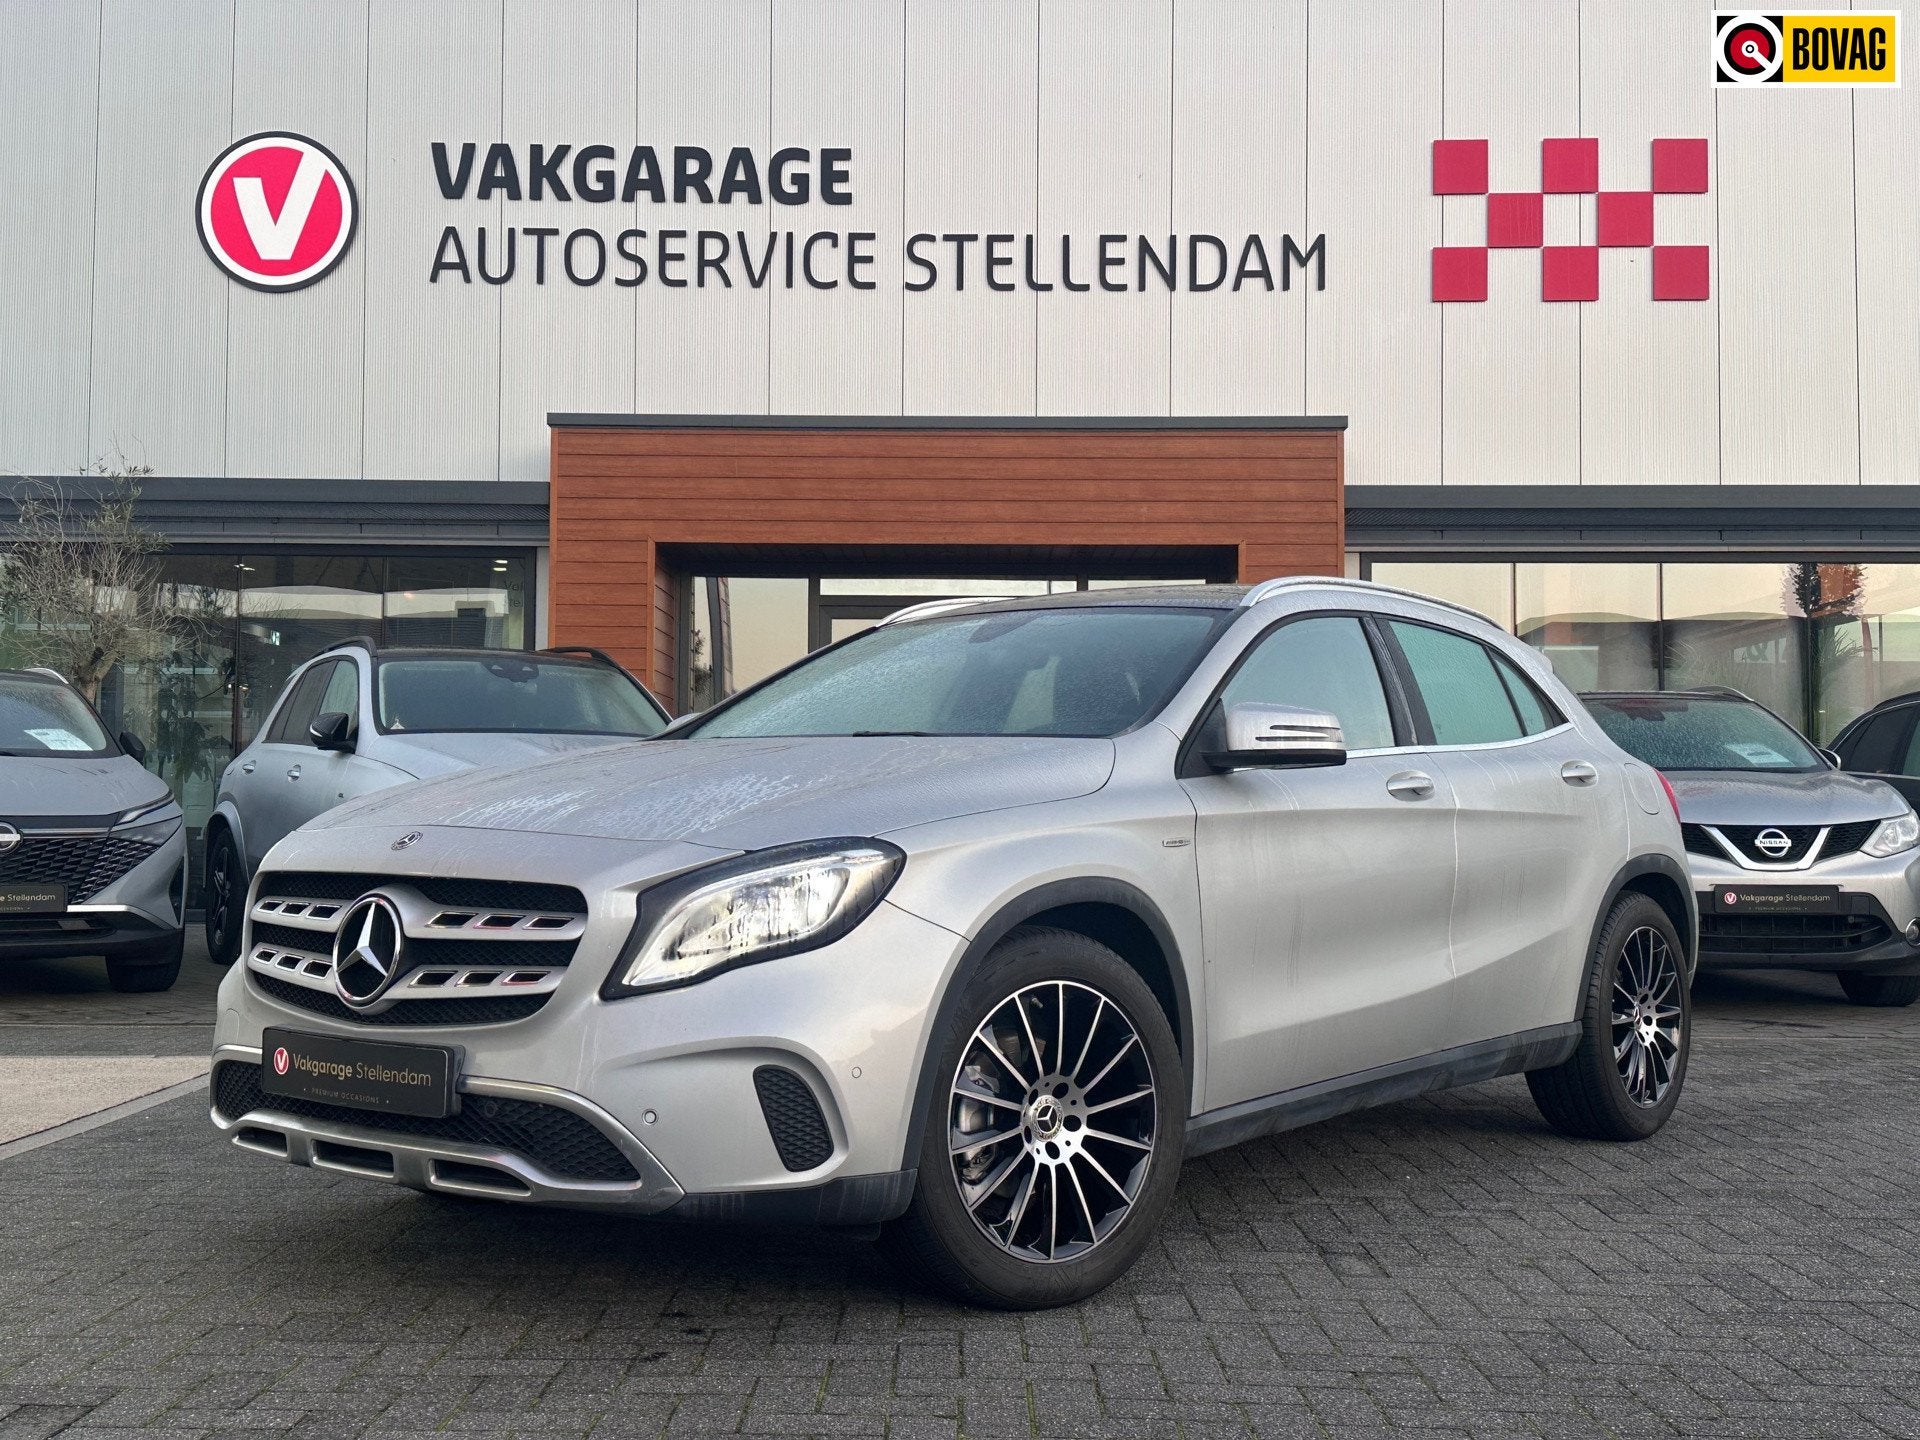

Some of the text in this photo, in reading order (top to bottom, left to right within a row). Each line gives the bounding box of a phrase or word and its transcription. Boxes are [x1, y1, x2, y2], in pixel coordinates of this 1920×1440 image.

[430, 141, 853, 206] VAKGARAGE
[429, 225, 1326, 293] AUTOSERVICE STELLENDAM
[1740, 894, 1784, 903] Vakgarage
[1785, 893, 1830, 902] Stellendam
[292, 1053, 353, 1081] Vakgarage
[356, 1062, 432, 1087] Stellendam
[341, 1092, 379, 1104] OCCASIONS
